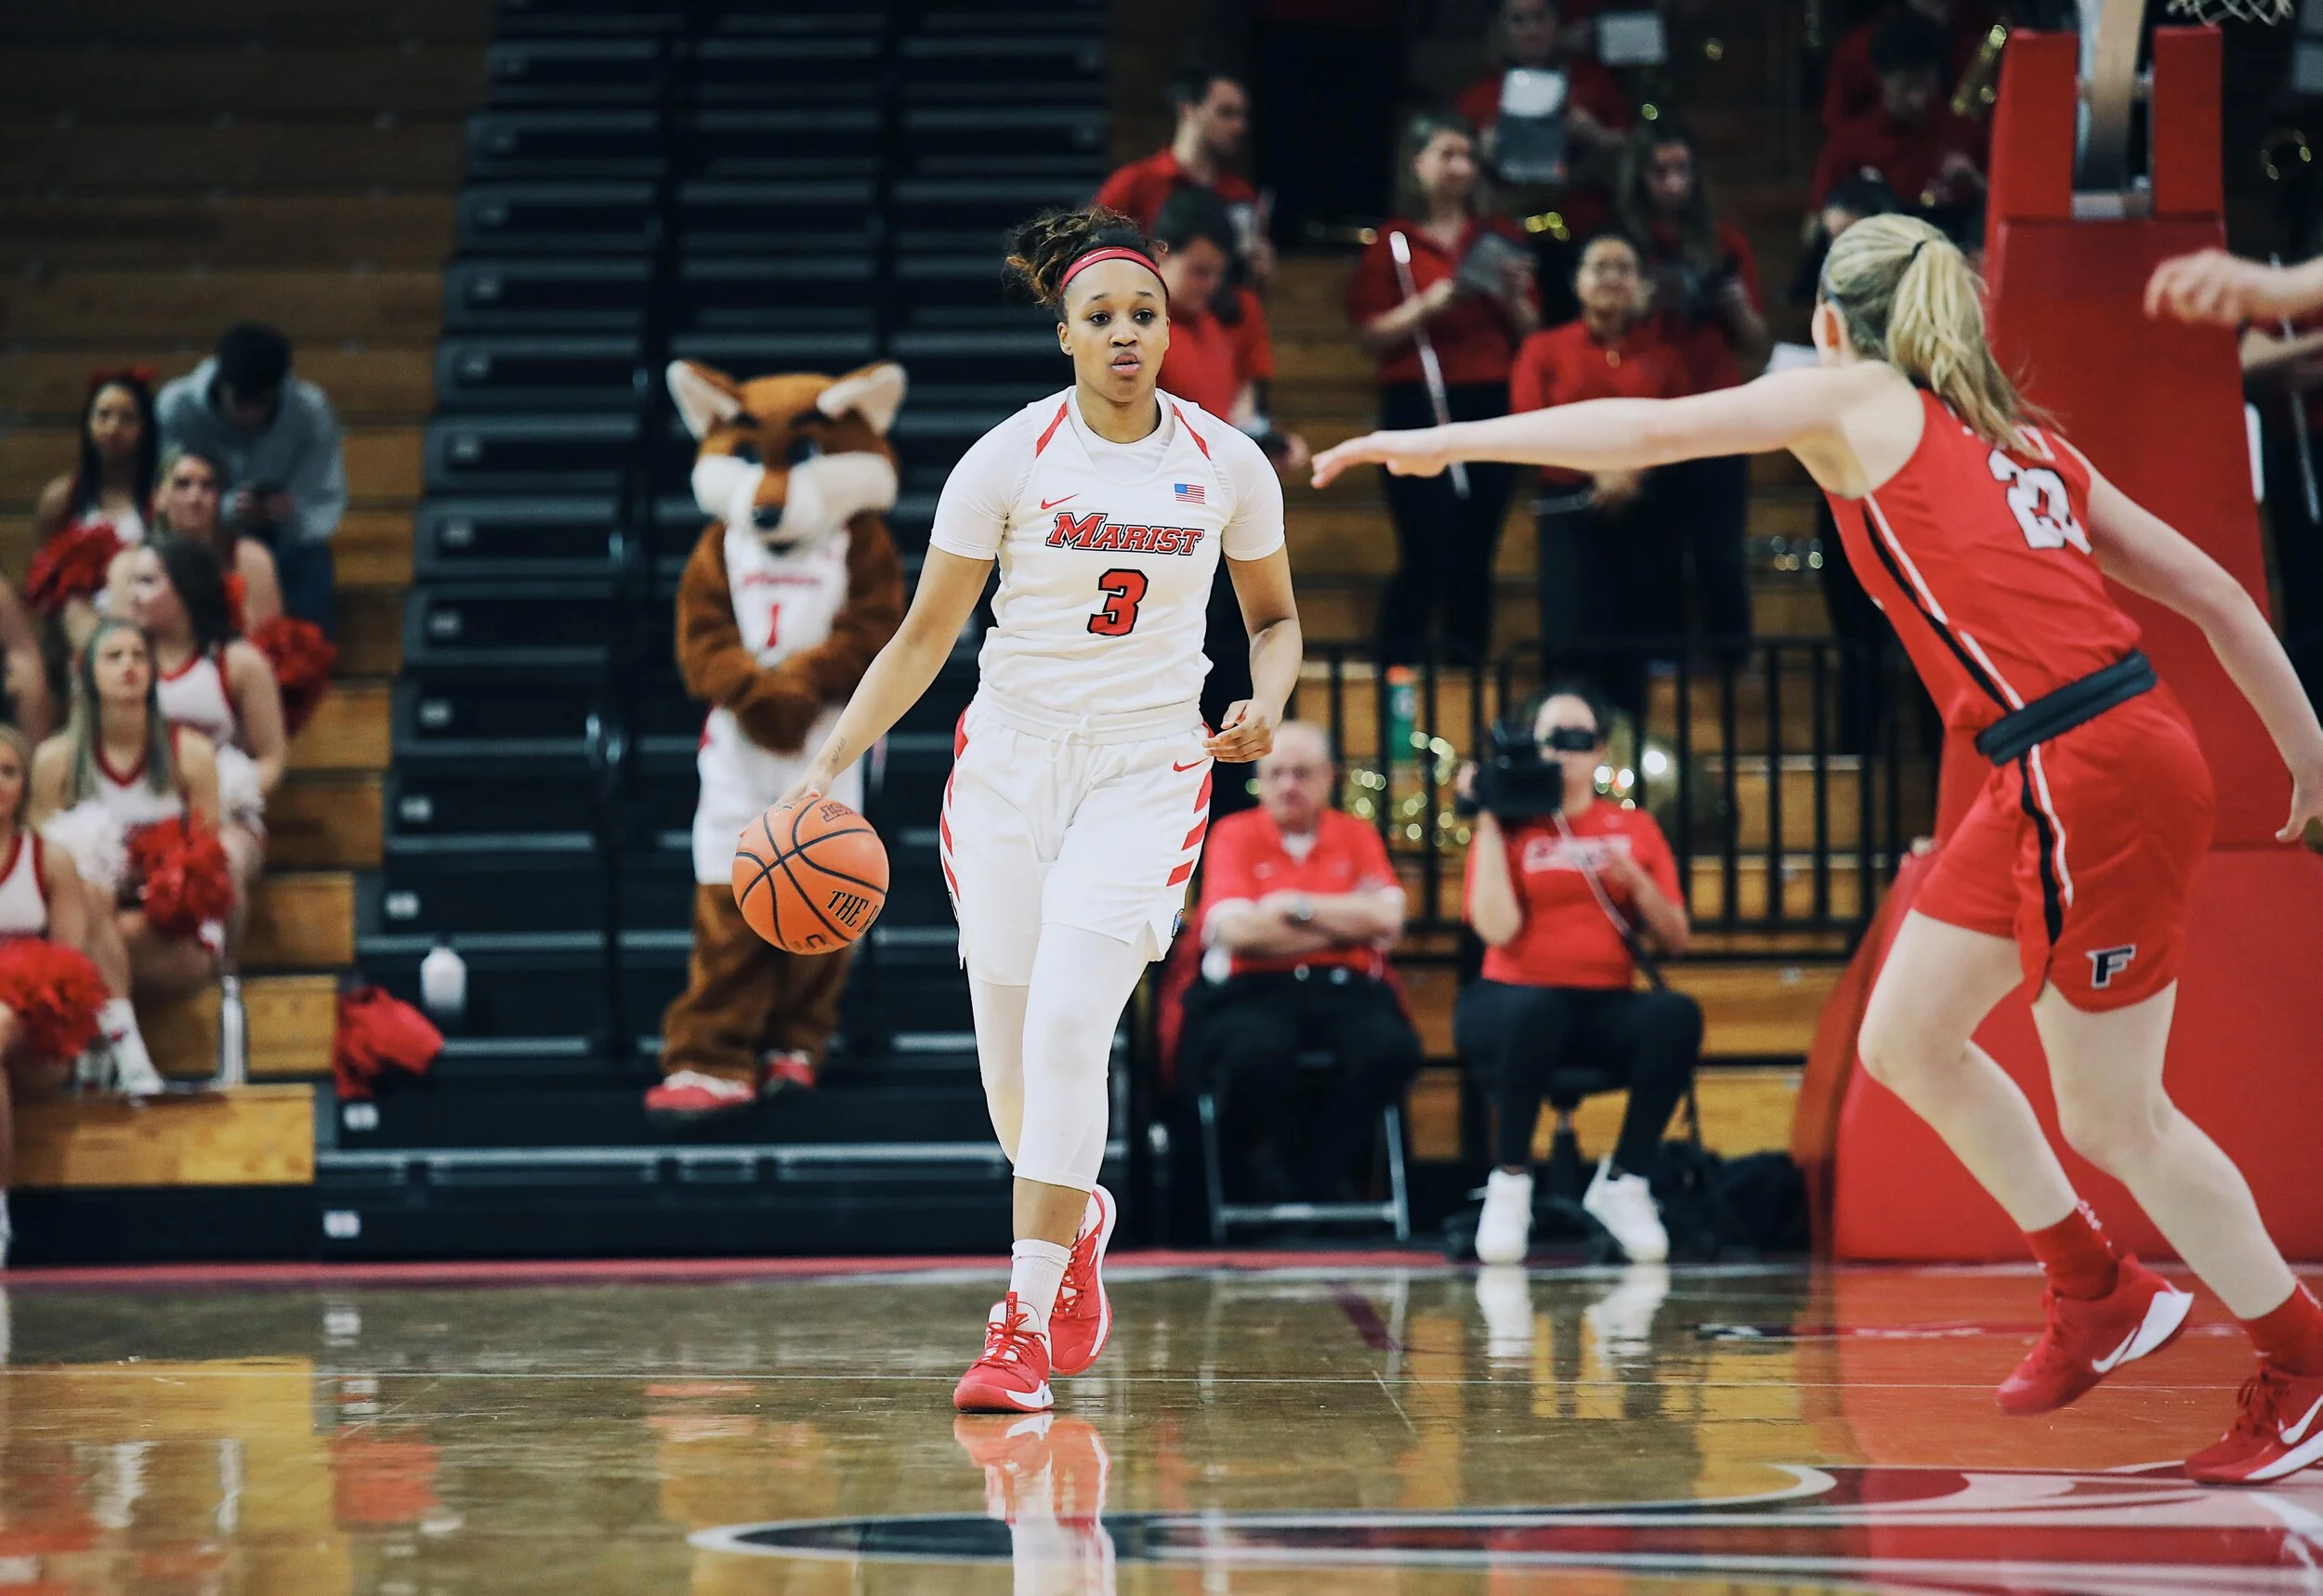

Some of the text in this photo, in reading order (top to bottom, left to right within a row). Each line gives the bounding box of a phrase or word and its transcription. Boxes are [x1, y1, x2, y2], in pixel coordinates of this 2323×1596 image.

[1045, 512, 1204, 556] MARIST
[1086, 568, 1148, 636] 3
[826, 890, 870, 928] THE
[2085, 943, 2136, 990] F
